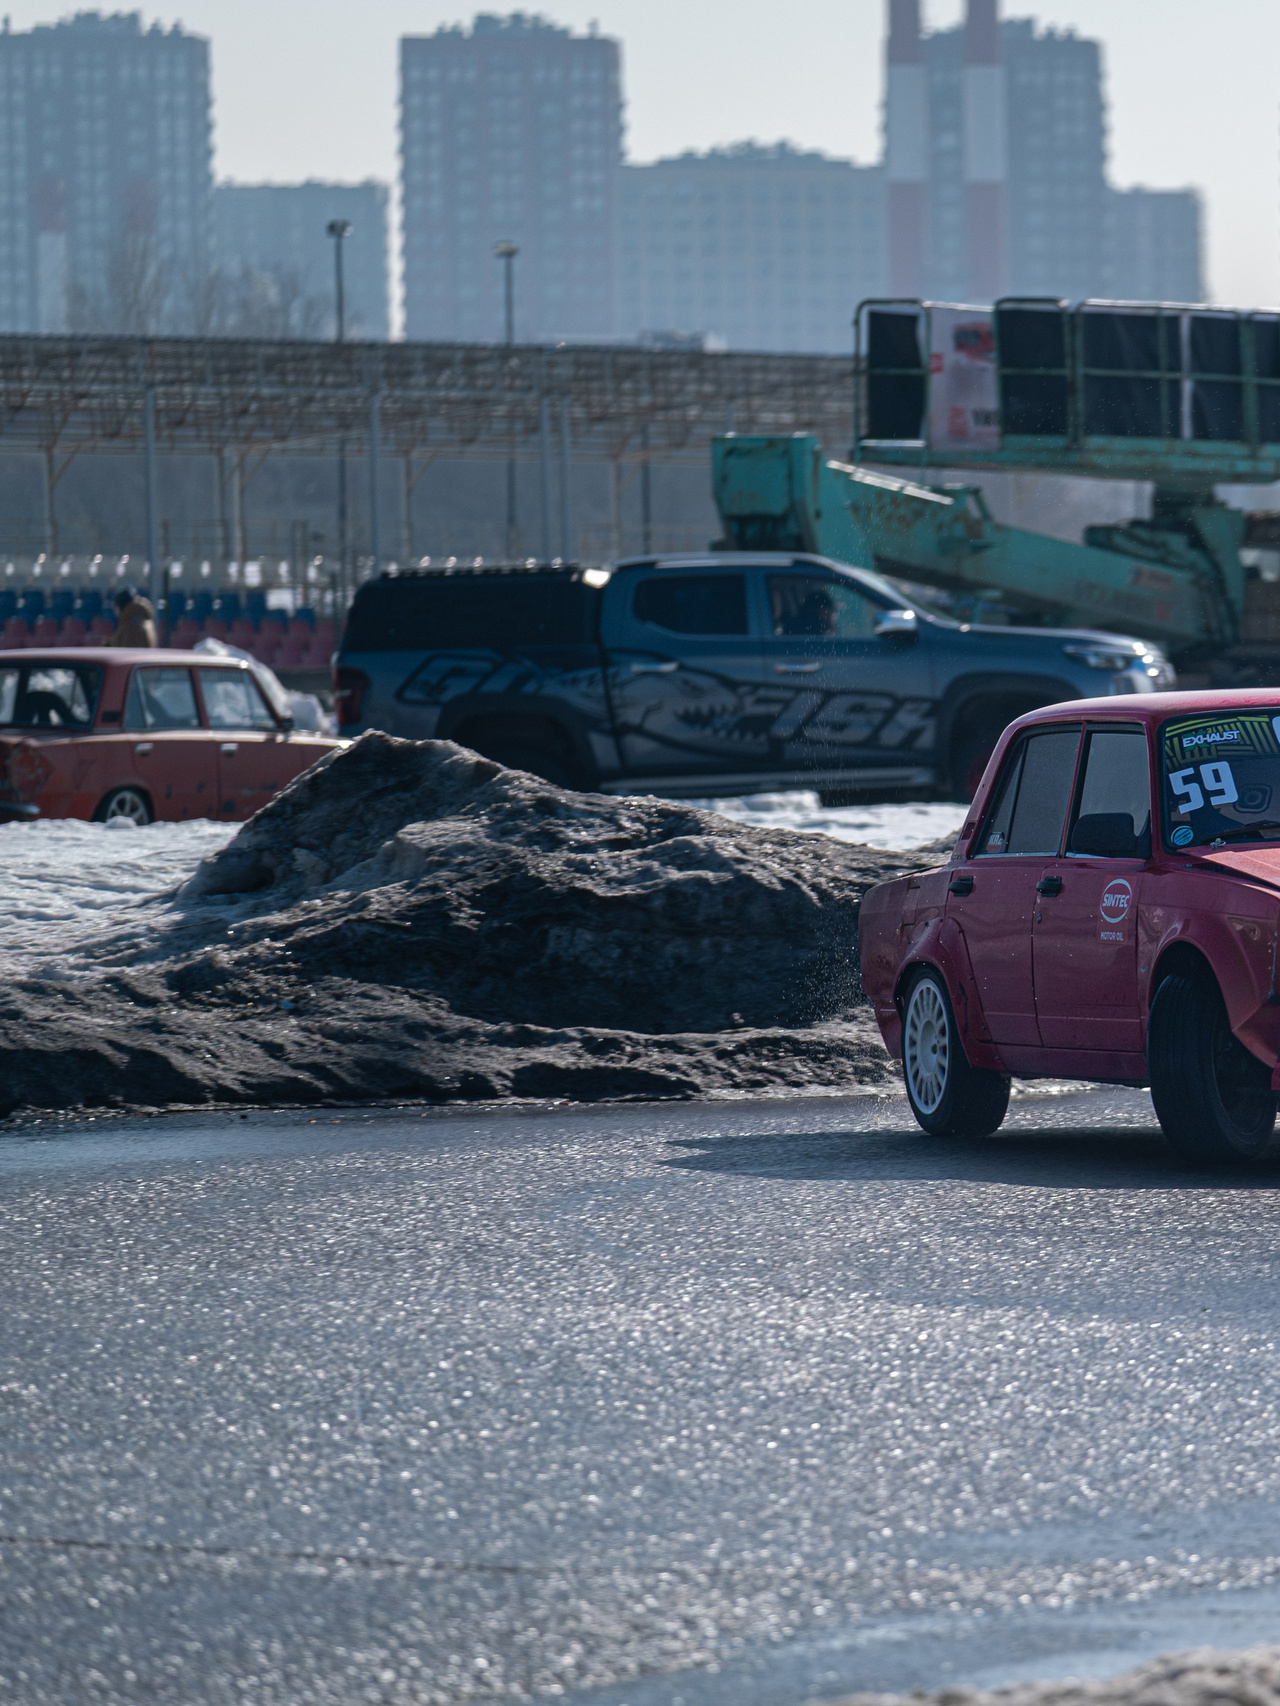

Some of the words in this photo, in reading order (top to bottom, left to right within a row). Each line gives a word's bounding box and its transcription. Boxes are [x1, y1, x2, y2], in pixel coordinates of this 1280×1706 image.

[1183, 730, 1240, 748] EXHAUST
[1168, 761, 1239, 815] 59
[1102, 894, 1130, 907] SINTEC
